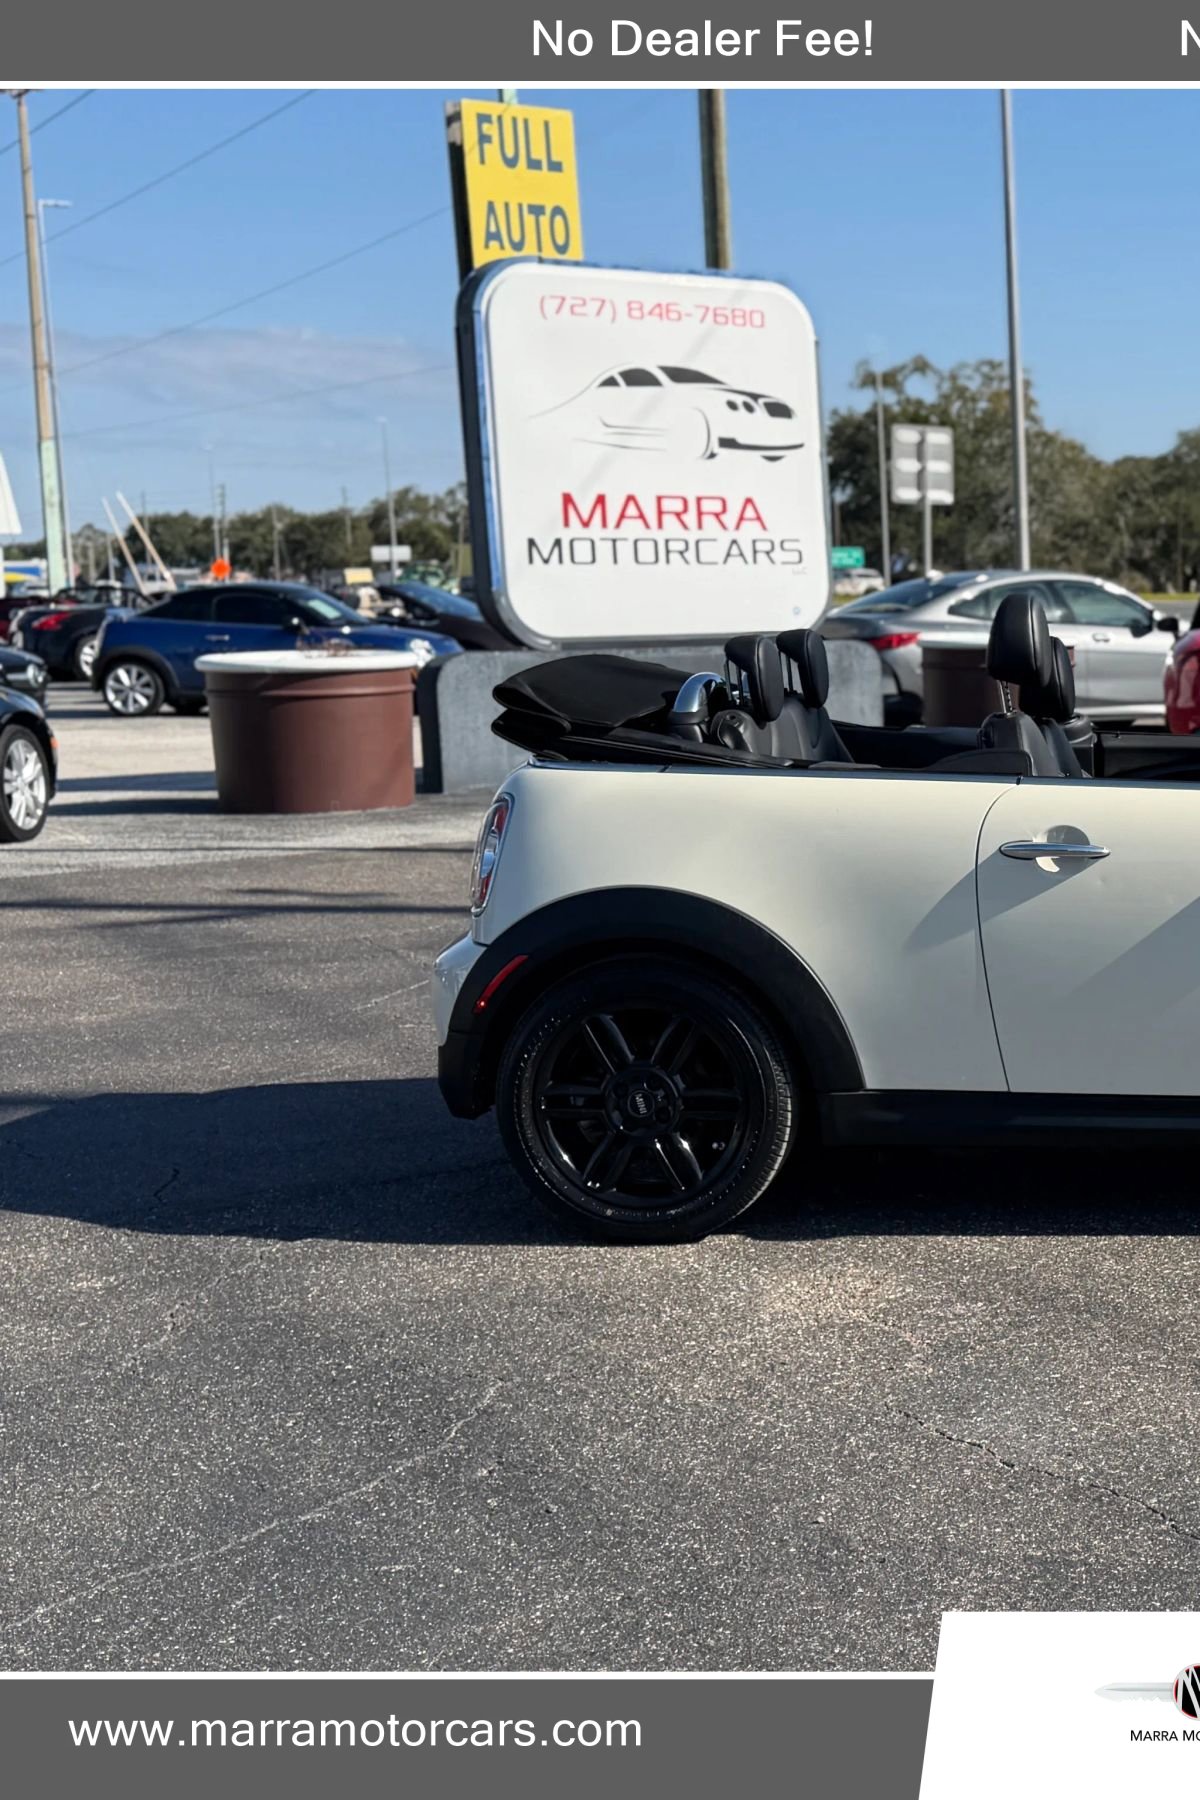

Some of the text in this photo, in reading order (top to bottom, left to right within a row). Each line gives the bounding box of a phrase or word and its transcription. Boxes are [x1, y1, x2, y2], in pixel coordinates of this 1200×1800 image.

[476, 112, 564, 173] FULL
[484, 200, 570, 255] AUTO
[539, 295, 765, 329] (727) 846-7680
[561, 491, 767, 530] MARRA
[527, 537, 803, 565] MOTORCARS
